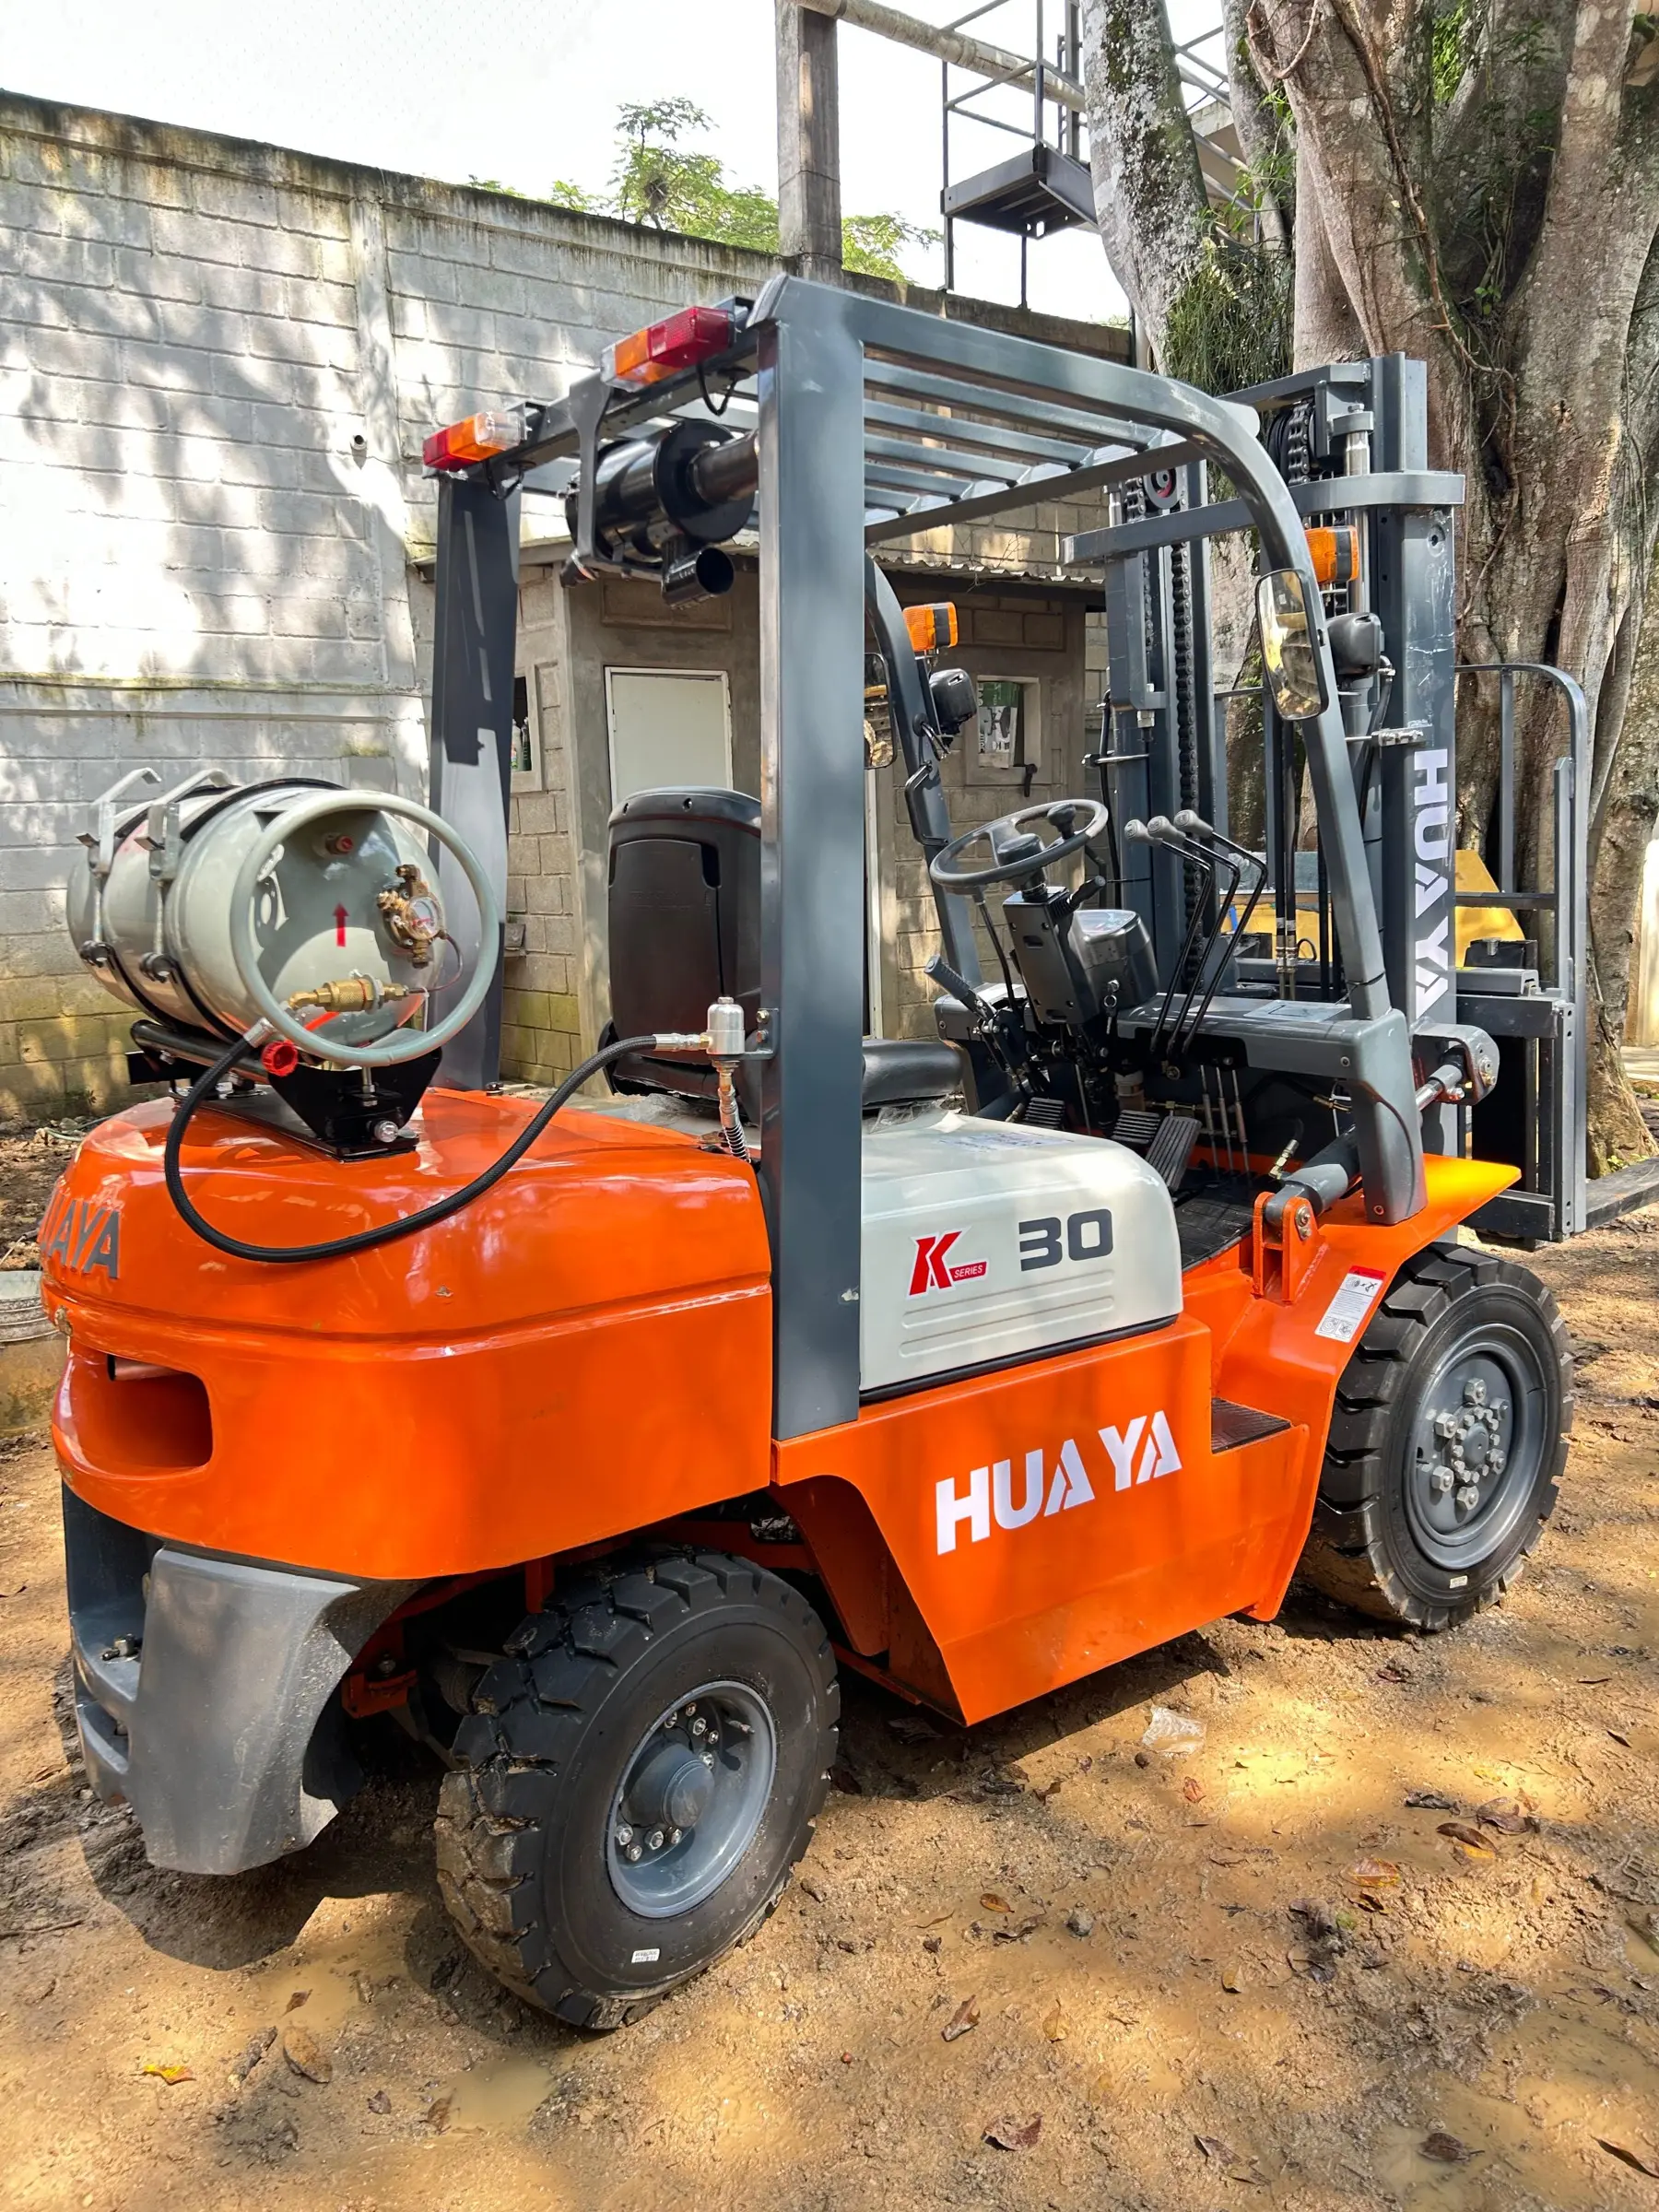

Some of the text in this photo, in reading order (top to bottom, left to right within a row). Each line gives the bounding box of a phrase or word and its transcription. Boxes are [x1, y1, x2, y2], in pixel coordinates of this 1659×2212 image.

[1414, 747, 1448, 1019] HUAYA
[908, 1229, 984, 1297] K SERIES
[1018, 1208, 1114, 1272] 30
